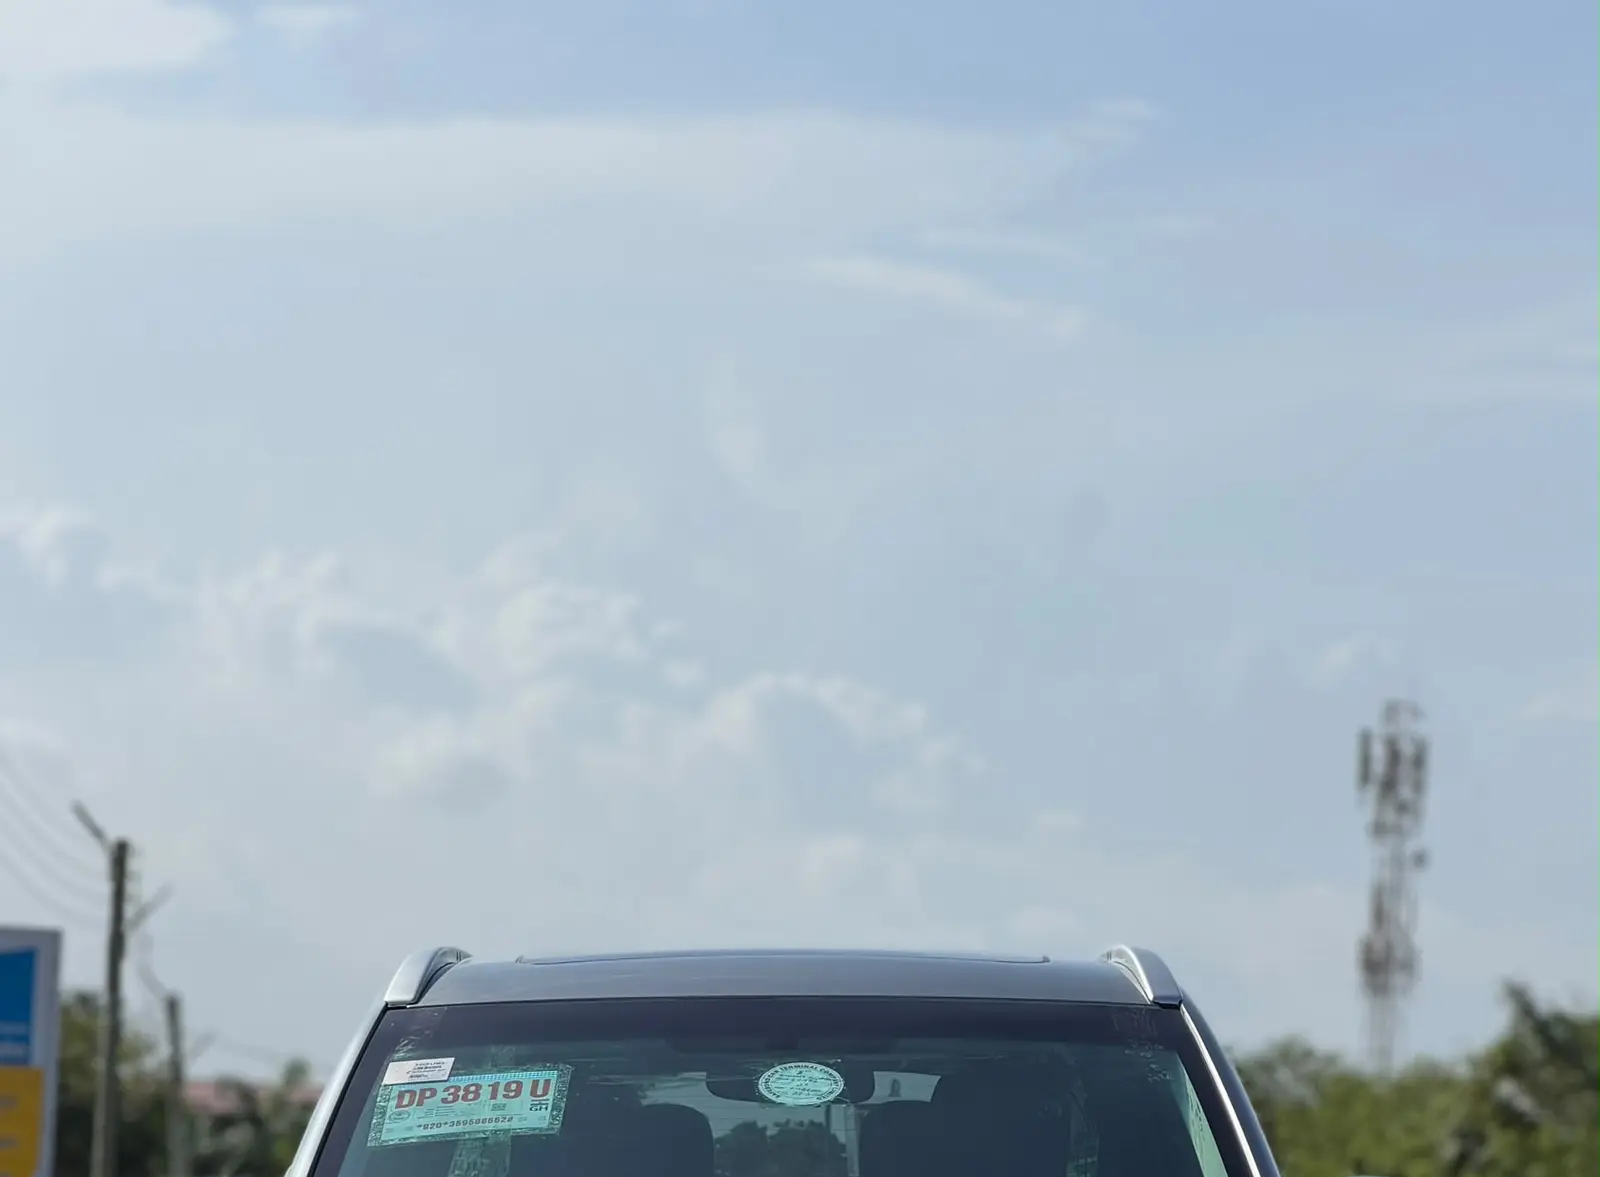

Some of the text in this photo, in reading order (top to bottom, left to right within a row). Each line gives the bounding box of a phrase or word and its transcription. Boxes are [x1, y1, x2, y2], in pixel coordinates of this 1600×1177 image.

[394, 1078, 552, 1110] DP 3819 U
[529, 1104, 549, 1112] GH
